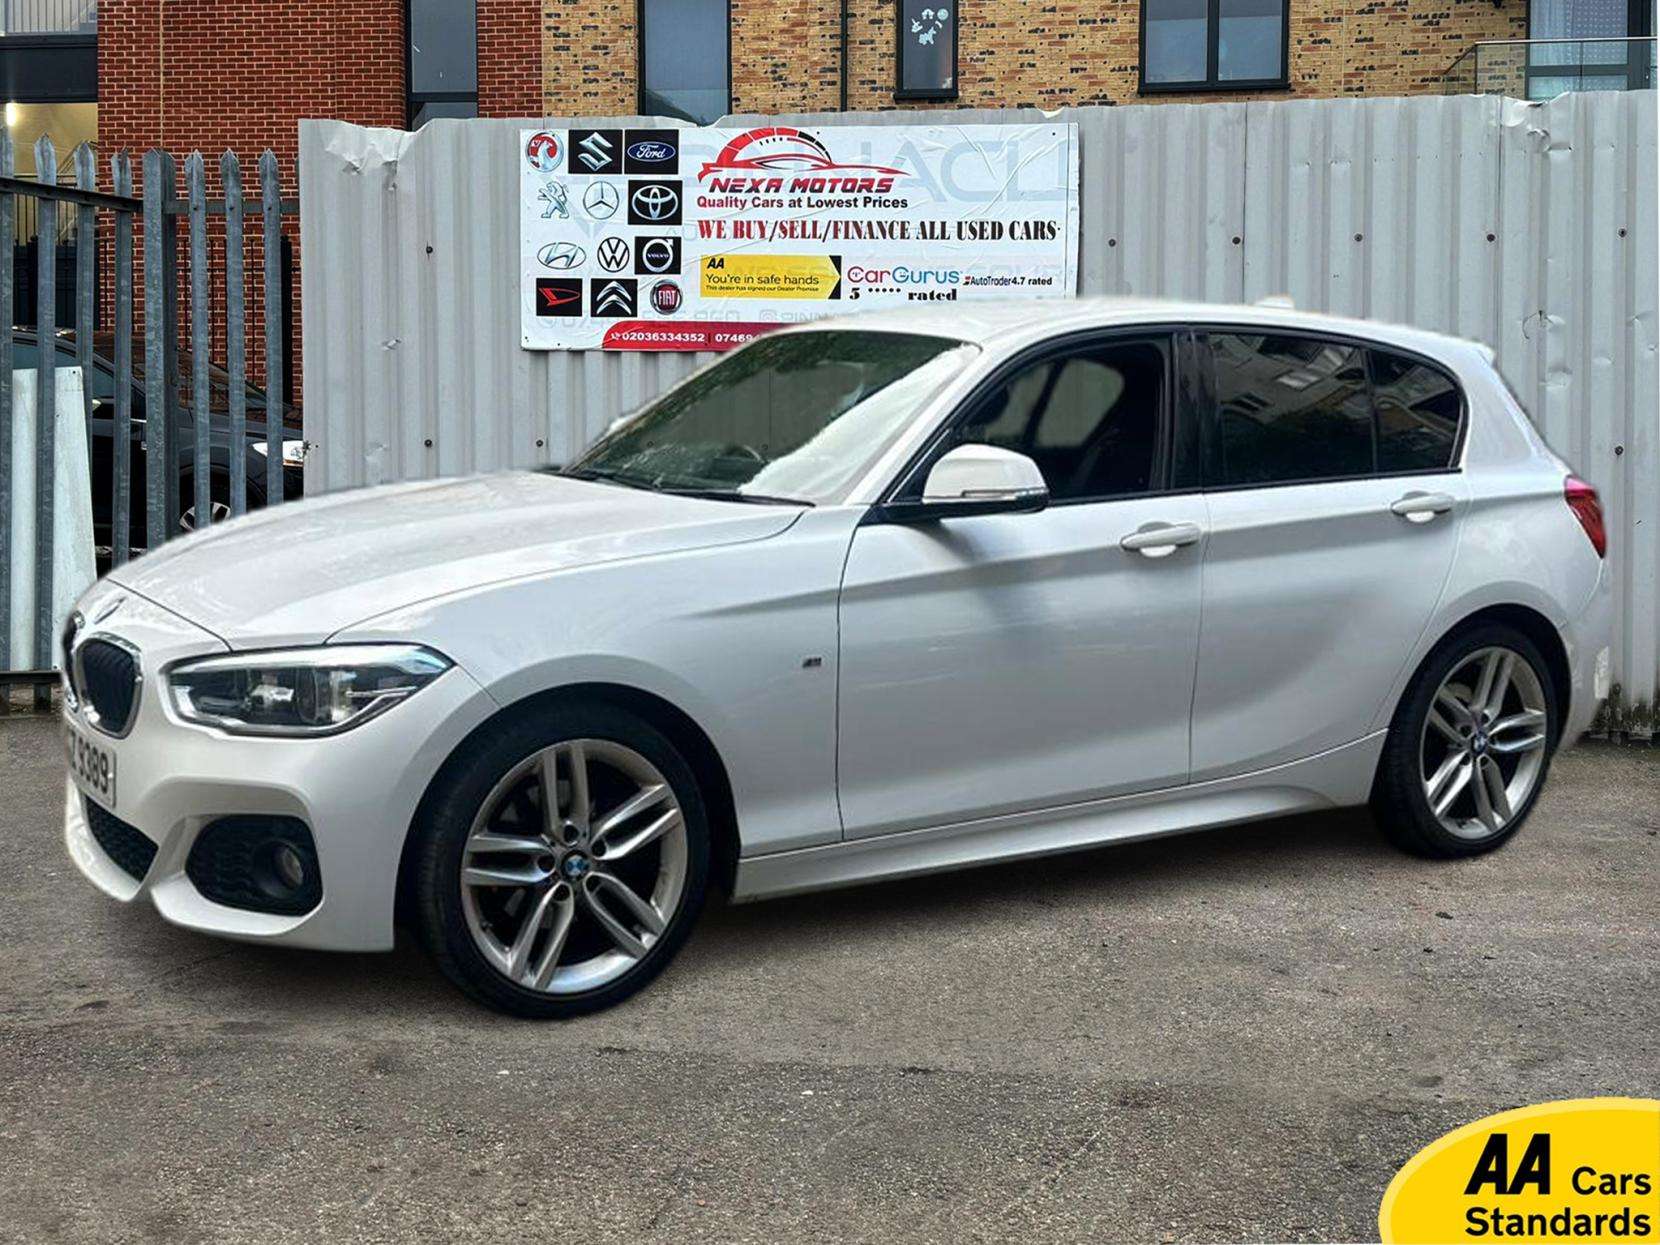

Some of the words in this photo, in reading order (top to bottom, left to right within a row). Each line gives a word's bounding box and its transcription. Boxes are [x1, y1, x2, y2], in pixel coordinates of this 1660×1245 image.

[637, 144, 666, 158] Ford
[709, 178, 783, 193] NEXA
[789, 178, 894, 193] MOTORS
[697, 196, 747, 210] Quality
[752, 196, 784, 208] Cars
[788, 196, 803, 208] at
[807, 196, 859, 208] Lowest
[863, 196, 908, 208] Prices
[698, 219, 727, 239] WE
[917, 221, 950, 240] ALL
[956, 221, 1004, 240] USED
[1009, 220, 1057, 240] CARS
[707, 257, 725, 269] AA
[706, 274, 741, 284] You're
[744, 274, 754, 283] in
[757, 274, 781, 284] safe
[784, 275, 819, 285] hands
[847, 266, 960, 284] CarGurus
[1028, 277, 1052, 285] rated
[658, 290, 677, 306] FIAT
[849, 288, 860, 300] 5
[908, 288, 957, 300] rated
[622, 332, 705, 343] 02036334352
